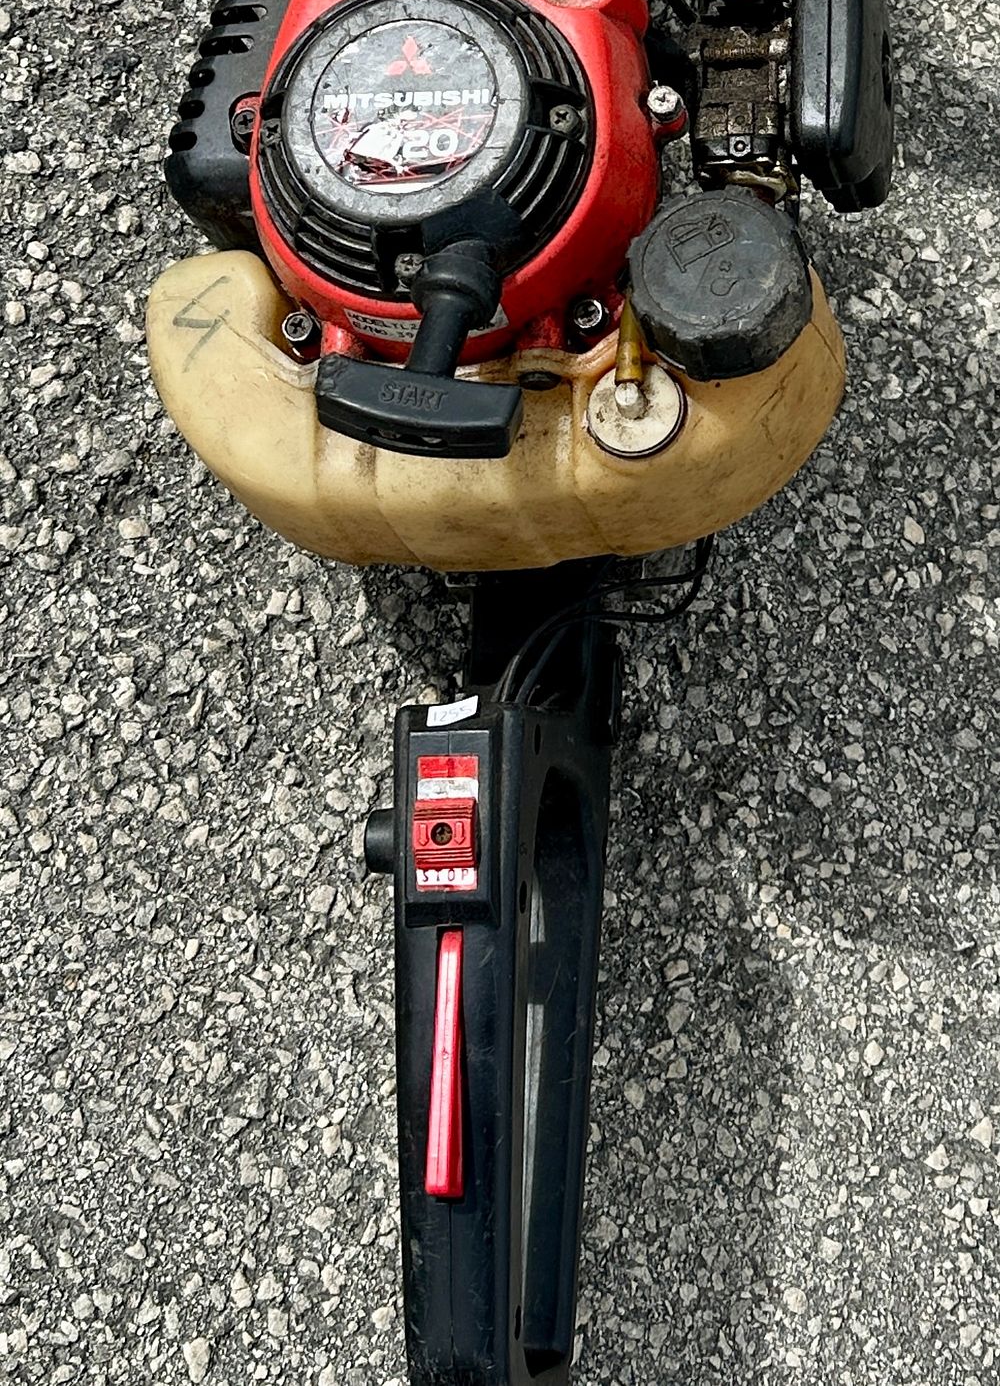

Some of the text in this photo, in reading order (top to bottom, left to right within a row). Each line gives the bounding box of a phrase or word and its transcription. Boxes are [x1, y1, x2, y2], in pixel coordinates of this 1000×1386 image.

[323, 88, 490, 109] MITSUBISHI
[379, 380, 449, 411] START
[422, 866, 469, 883] STOP
